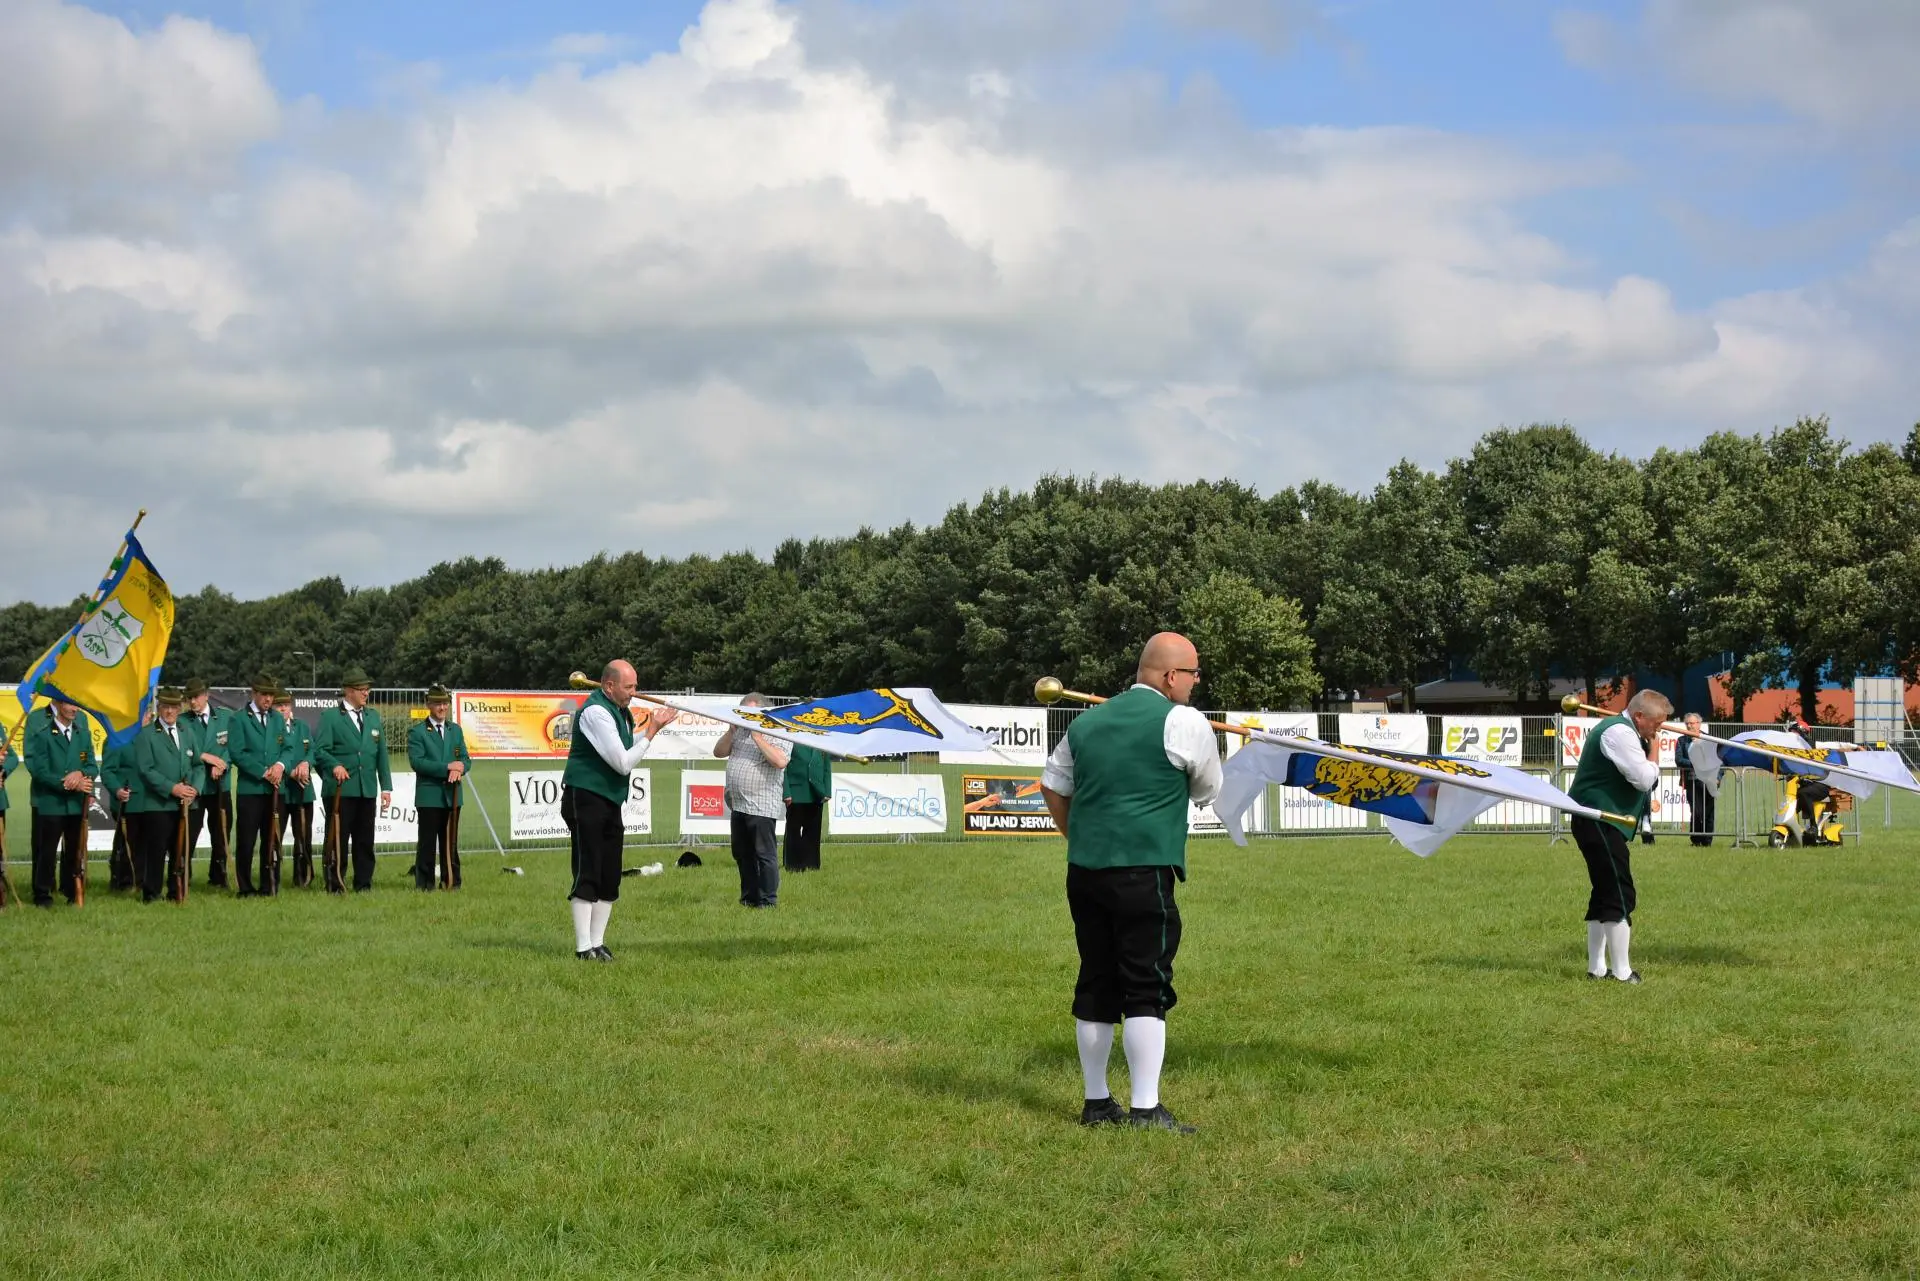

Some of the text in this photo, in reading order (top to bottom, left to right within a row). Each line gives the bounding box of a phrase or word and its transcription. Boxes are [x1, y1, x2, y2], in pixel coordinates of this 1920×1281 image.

[1446, 726, 1518, 753] EP EP
[1485, 754, 1519, 763] computers
[967, 780, 985, 789] JCB
[693, 797, 721, 808] BOSCH
[834, 788, 941, 818] Rotonde
[624, 822, 649, 834] engelo
